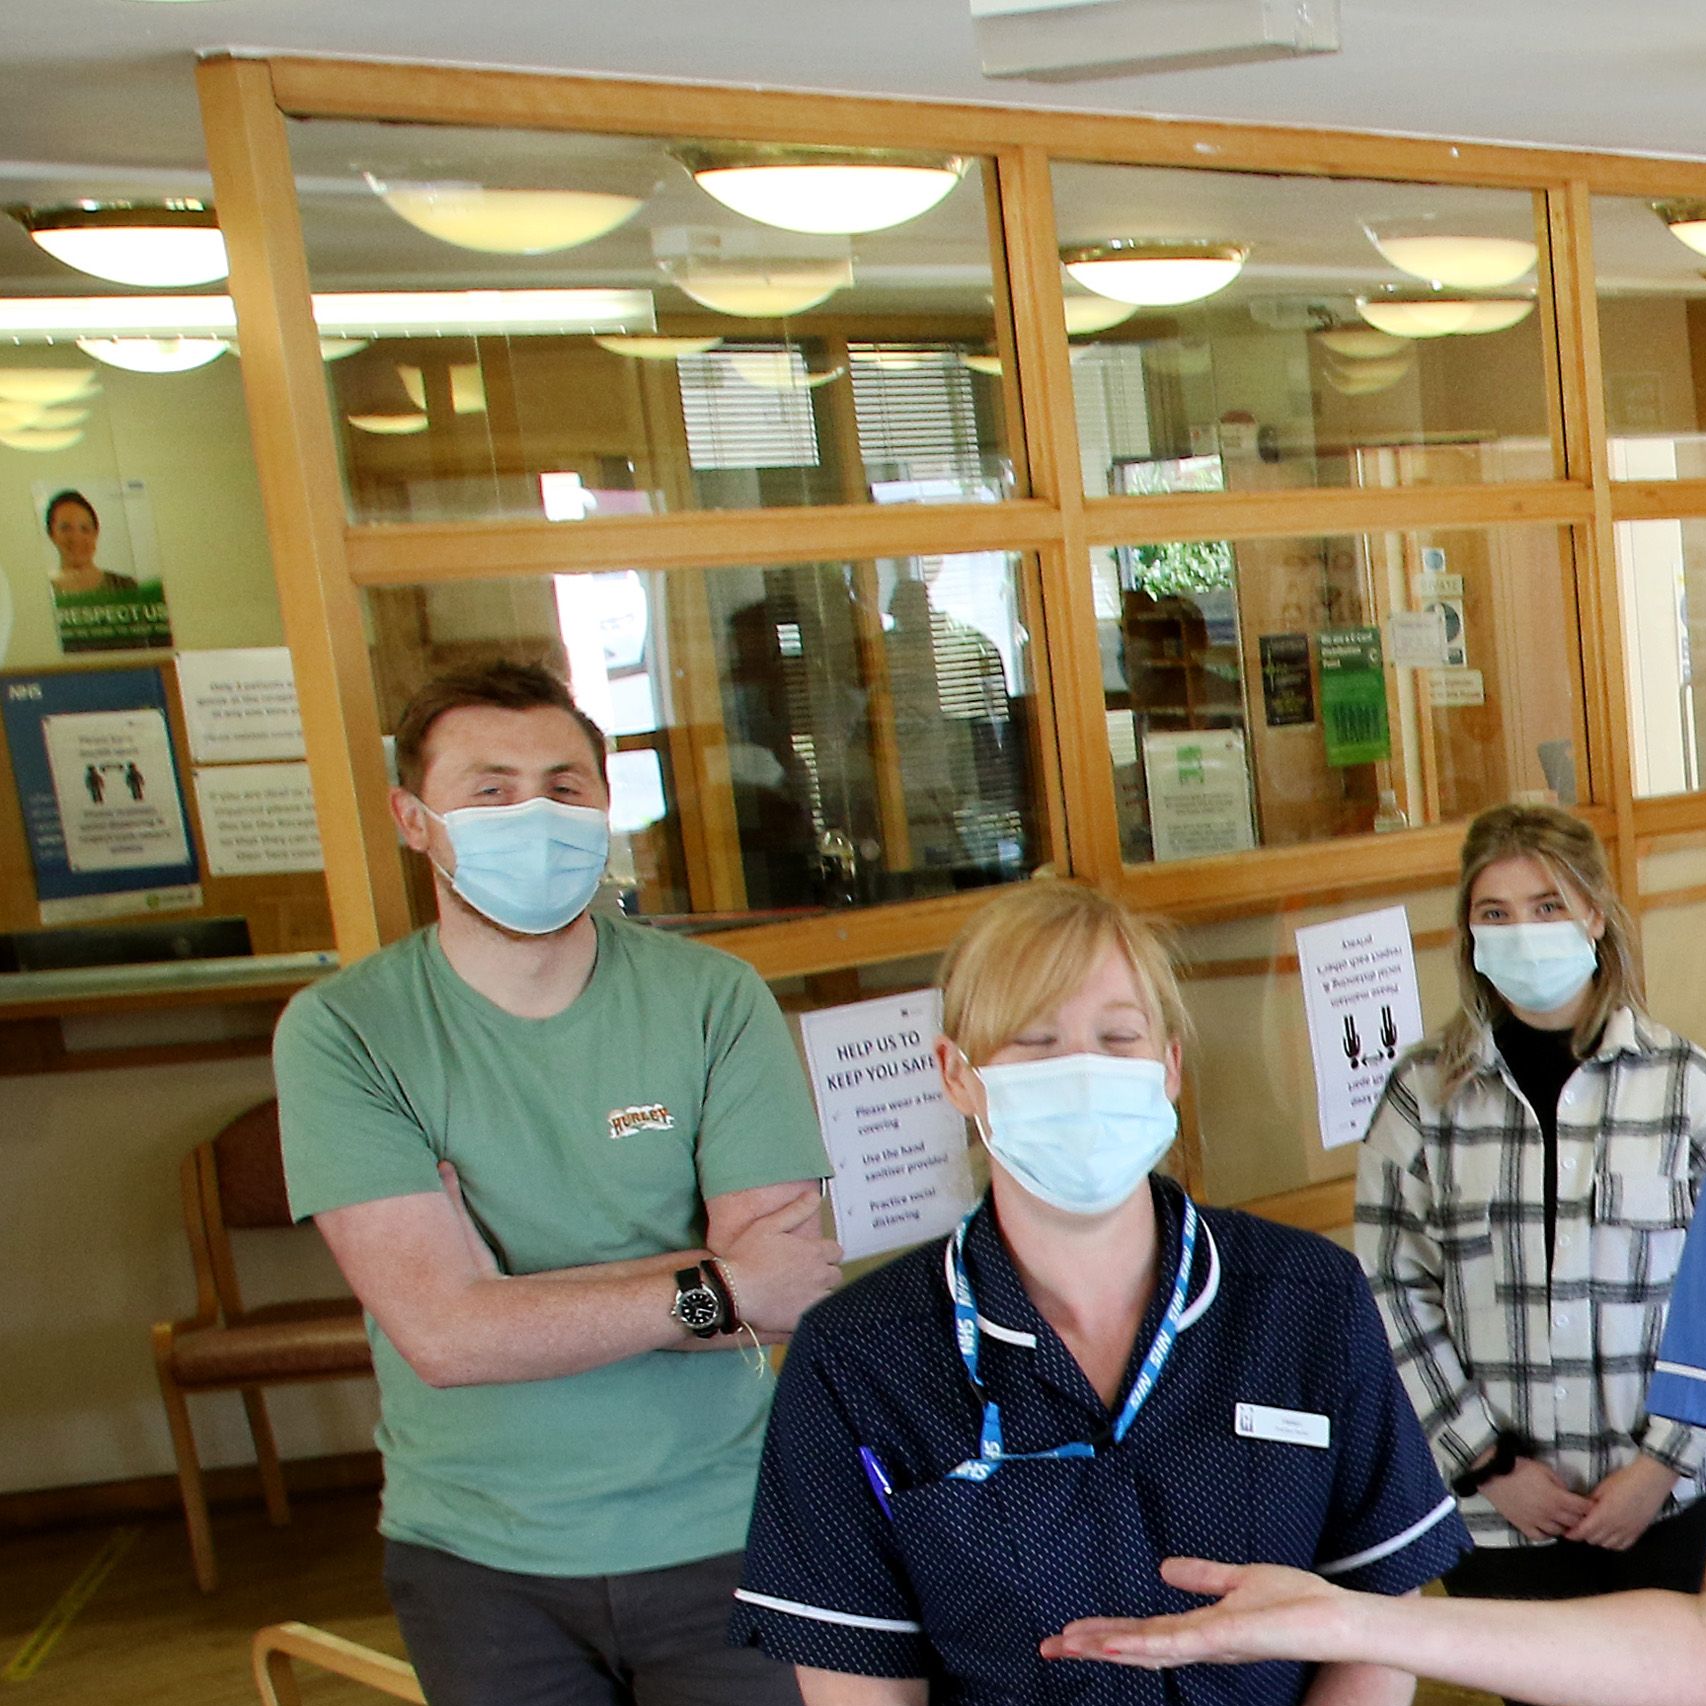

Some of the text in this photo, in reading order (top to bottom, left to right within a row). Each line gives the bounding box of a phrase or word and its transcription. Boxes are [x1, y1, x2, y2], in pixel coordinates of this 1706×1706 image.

[837, 1029, 921, 1062] HELP US TO
[826, 1054, 935, 1091] KEEP YOU SAFE
[856, 1102, 887, 1118] Please
[888, 1097, 913, 1110] wear
[922, 1090, 944, 1103] face
[611, 1106, 670, 1136] HURLEY
[857, 1118, 900, 1137] covering
[881, 1148, 900, 1160] the
[900, 1140, 926, 1155] hand
[869, 1186, 936, 1212] Practice social
[871, 1209, 921, 1230] distancing
[1168, 1285, 1186, 1324] NHS
[956, 1317, 976, 1356] NHS
[1149, 1327, 1174, 1370] NHS
[1128, 1370, 1152, 1411] NHS
